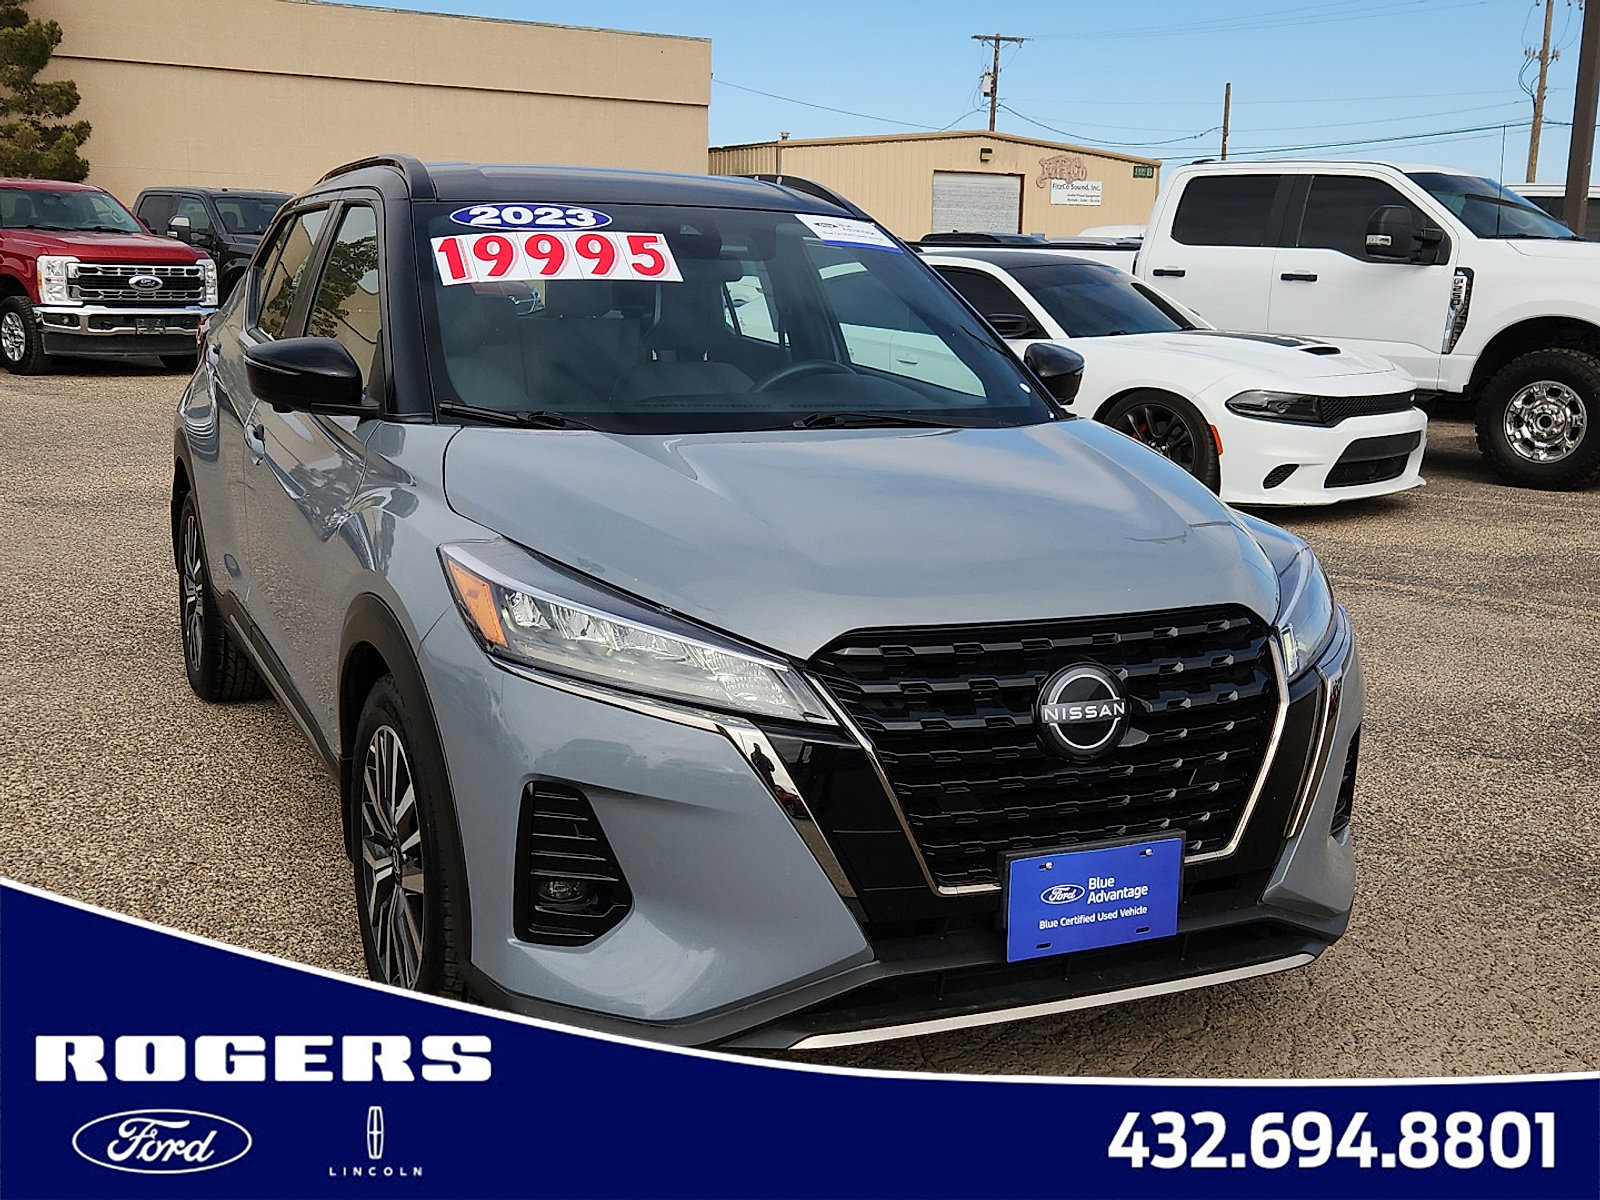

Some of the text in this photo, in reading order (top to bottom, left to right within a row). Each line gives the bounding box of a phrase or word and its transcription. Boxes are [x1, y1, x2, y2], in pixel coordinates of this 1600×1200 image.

[469, 206, 597, 227] 2023
[437, 233, 670, 280] 19995
[1044, 702, 1126, 721] NISSAN
[1088, 877, 1115, 890] Blue
[1048, 886, 1077, 902] Ford
[1087, 885, 1149, 904] Advantage
[1039, 905, 1148, 930] Blue Certified Used Vehicle
